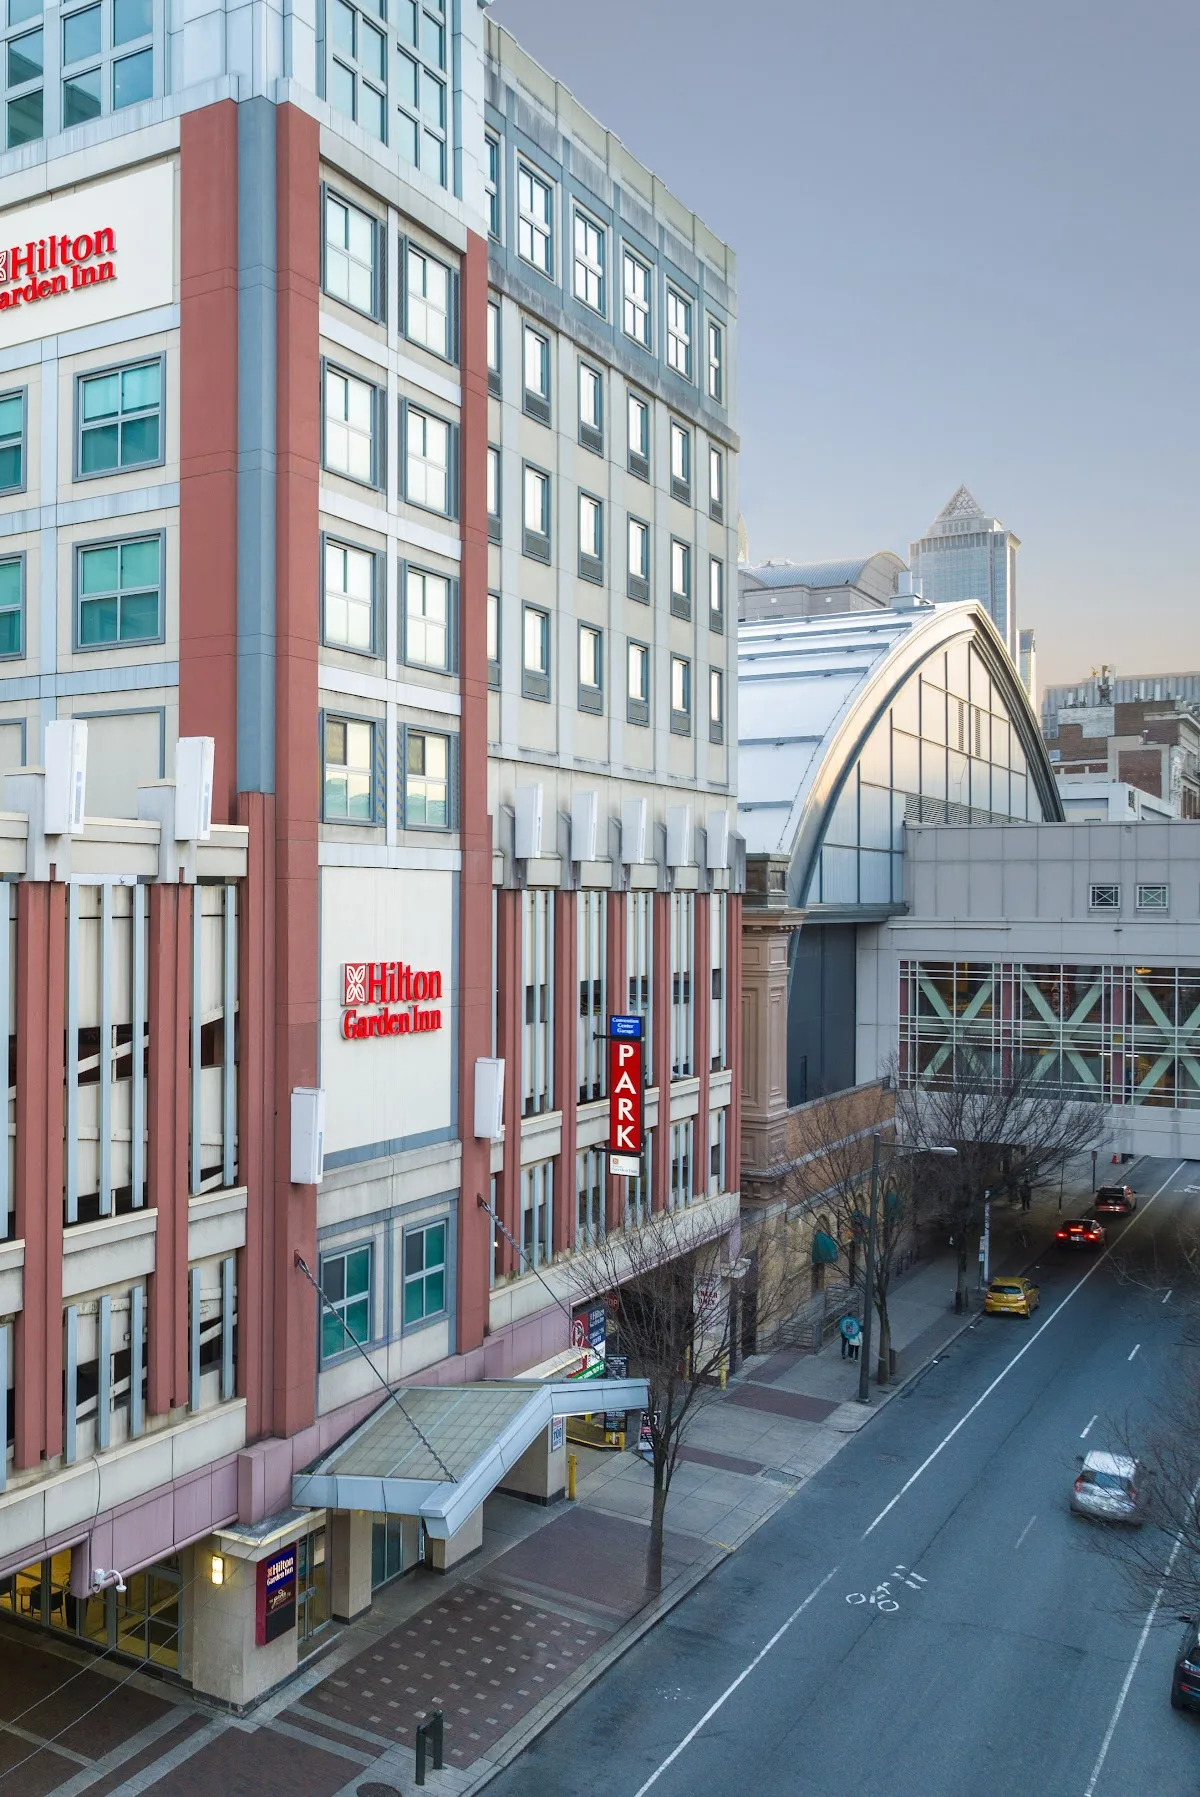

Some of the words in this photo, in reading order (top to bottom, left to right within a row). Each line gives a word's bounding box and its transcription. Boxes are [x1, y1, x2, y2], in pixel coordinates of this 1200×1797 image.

[9, 226, 116, 281] Hilton
[71, 260, 116, 290] Inn
[367, 961, 443, 1003] Hilton
[342, 1007, 410, 1040] Garden
[412, 1004, 443, 1032] Inn
[614, 1044, 637, 1149] PARK
[267, 1571, 285, 1586] Garden
[285, 1567, 293, 1576] Inn
[272, 1557, 293, 1575] Hilton
